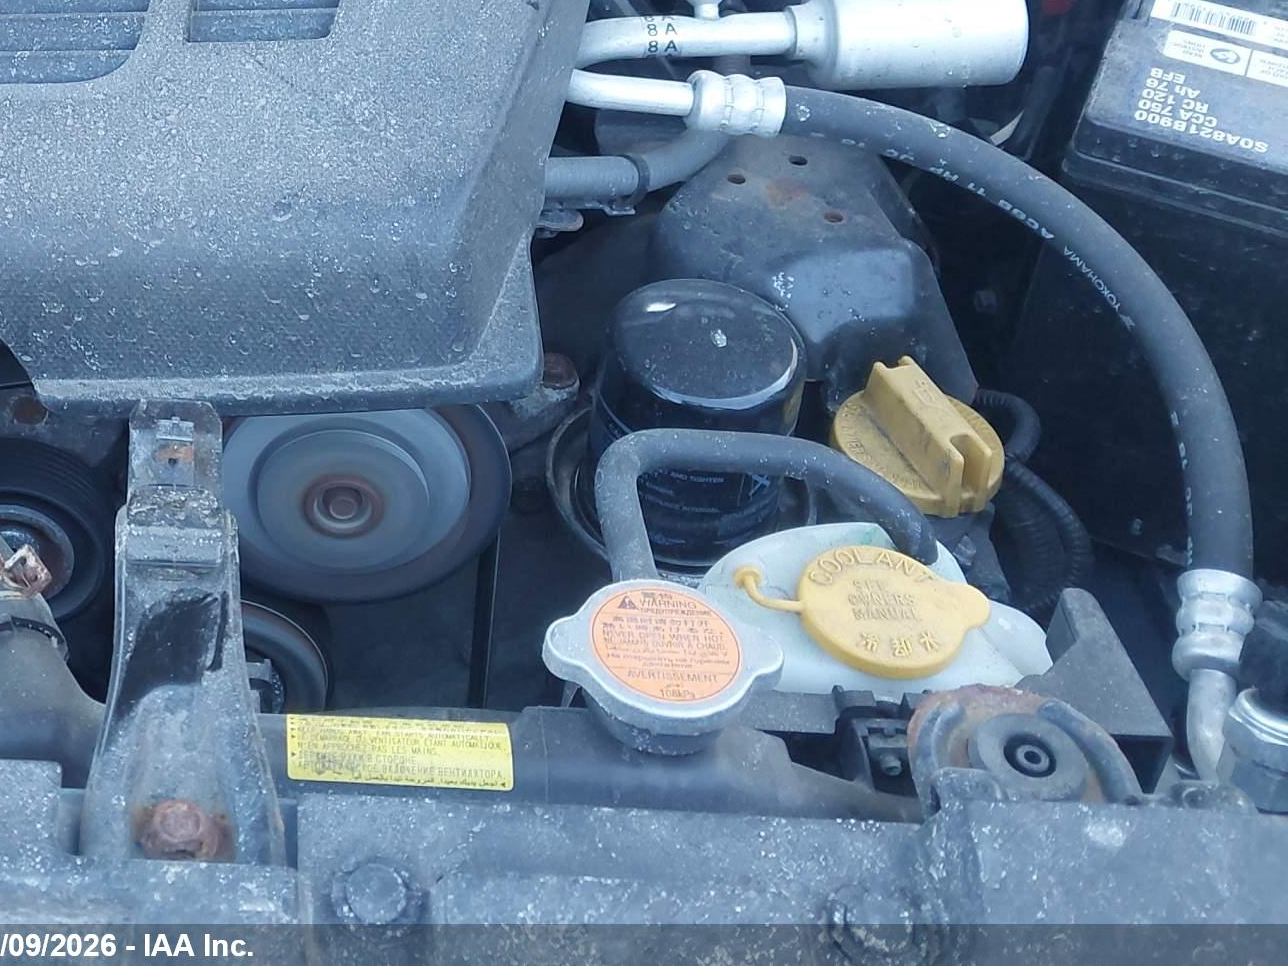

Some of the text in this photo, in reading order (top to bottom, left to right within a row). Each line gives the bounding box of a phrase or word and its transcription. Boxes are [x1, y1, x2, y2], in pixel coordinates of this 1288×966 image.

[1145, 76, 1201, 99] Ah 76
[1150, 67, 1186, 84] EFB
[1138, 98, 1218, 128] CCA 750
[1142, 87, 1209, 114] RC 120
[1063, 245, 1122, 312] YOKOHAMA
[808, 546, 934, 587] COOLANT
[639, 598, 697, 610] WARNING
[626, 668, 719, 683] AVERTISSEMENT
